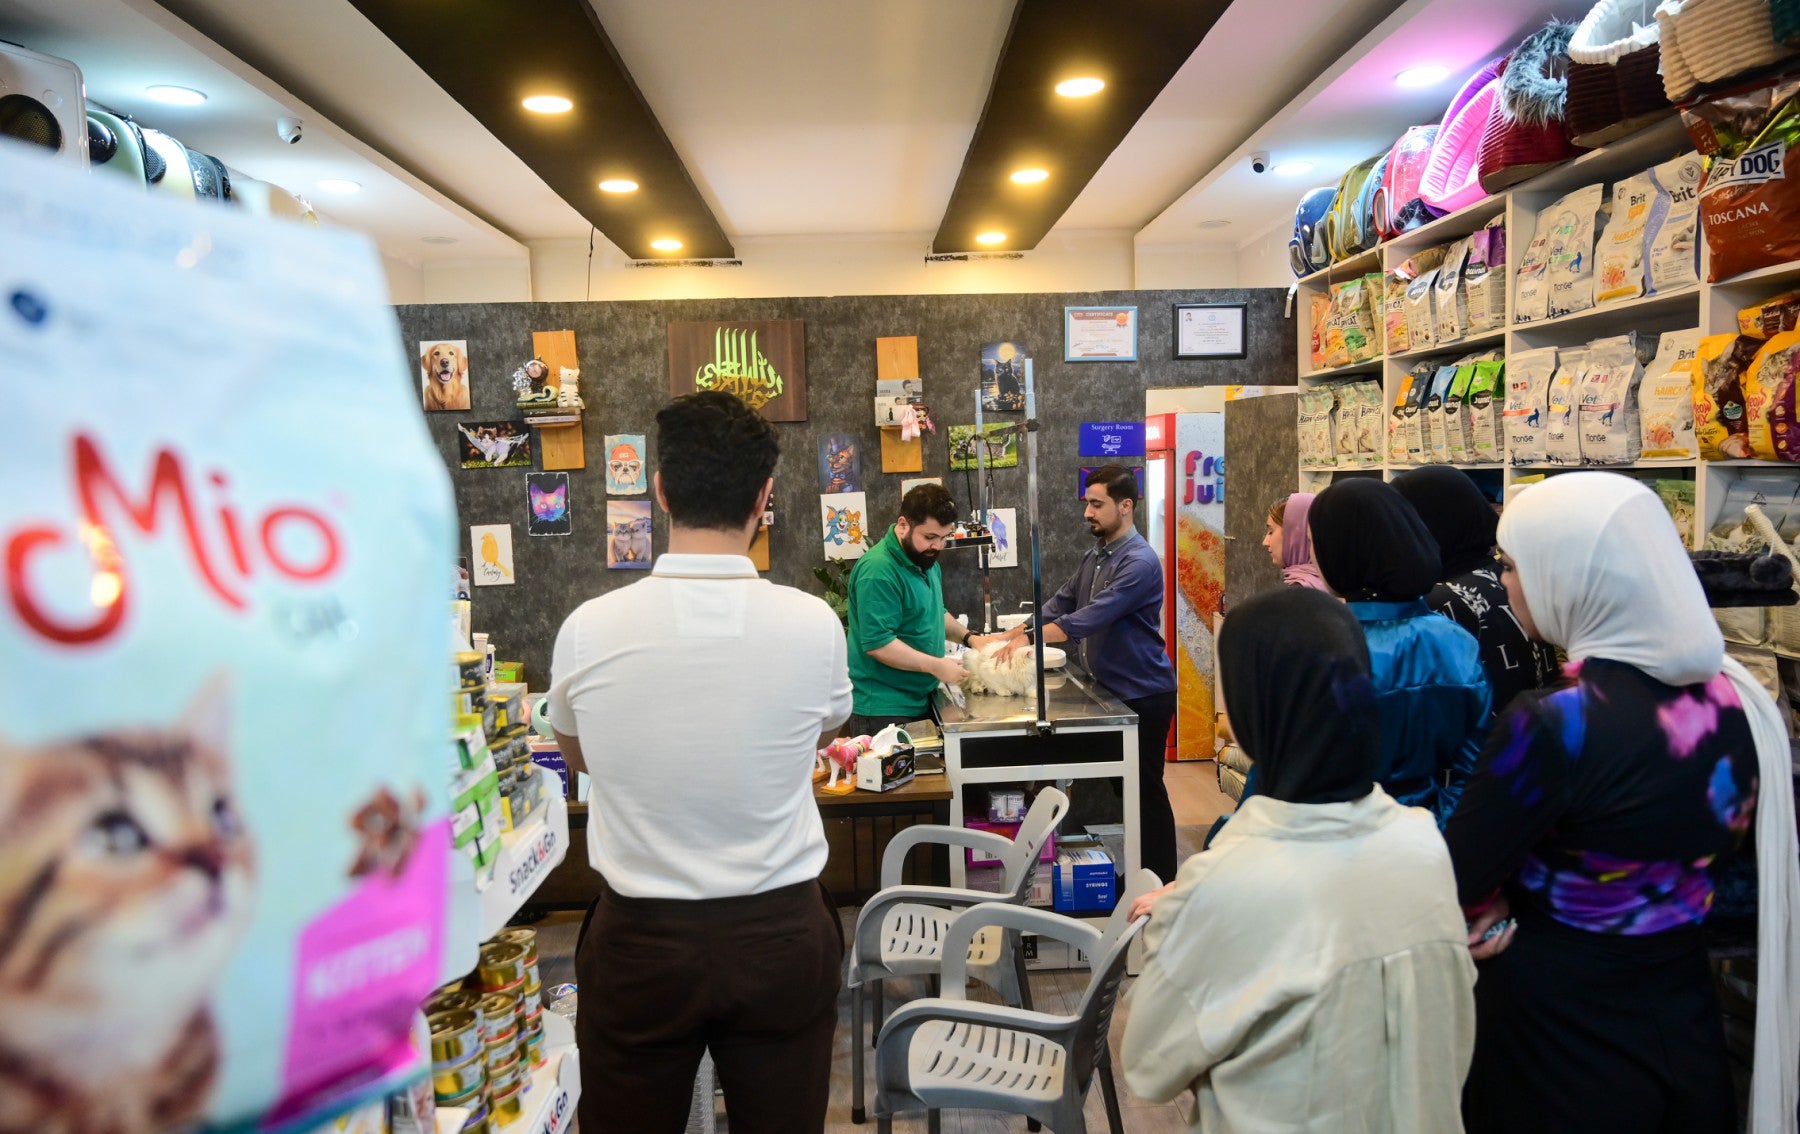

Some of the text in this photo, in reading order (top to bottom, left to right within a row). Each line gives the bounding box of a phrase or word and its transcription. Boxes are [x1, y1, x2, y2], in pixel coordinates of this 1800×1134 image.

[1740, 149, 1781, 176] DOG
[1630, 193, 1646, 206] Brit
[1669, 186, 1697, 204] Brit
[1708, 201, 1770, 226] TOSCANA
[1678, 349, 1696, 360] Brit
[1091, 424, 1114, 432] Surgery
[509, 831, 556, 894] Snack&Go
